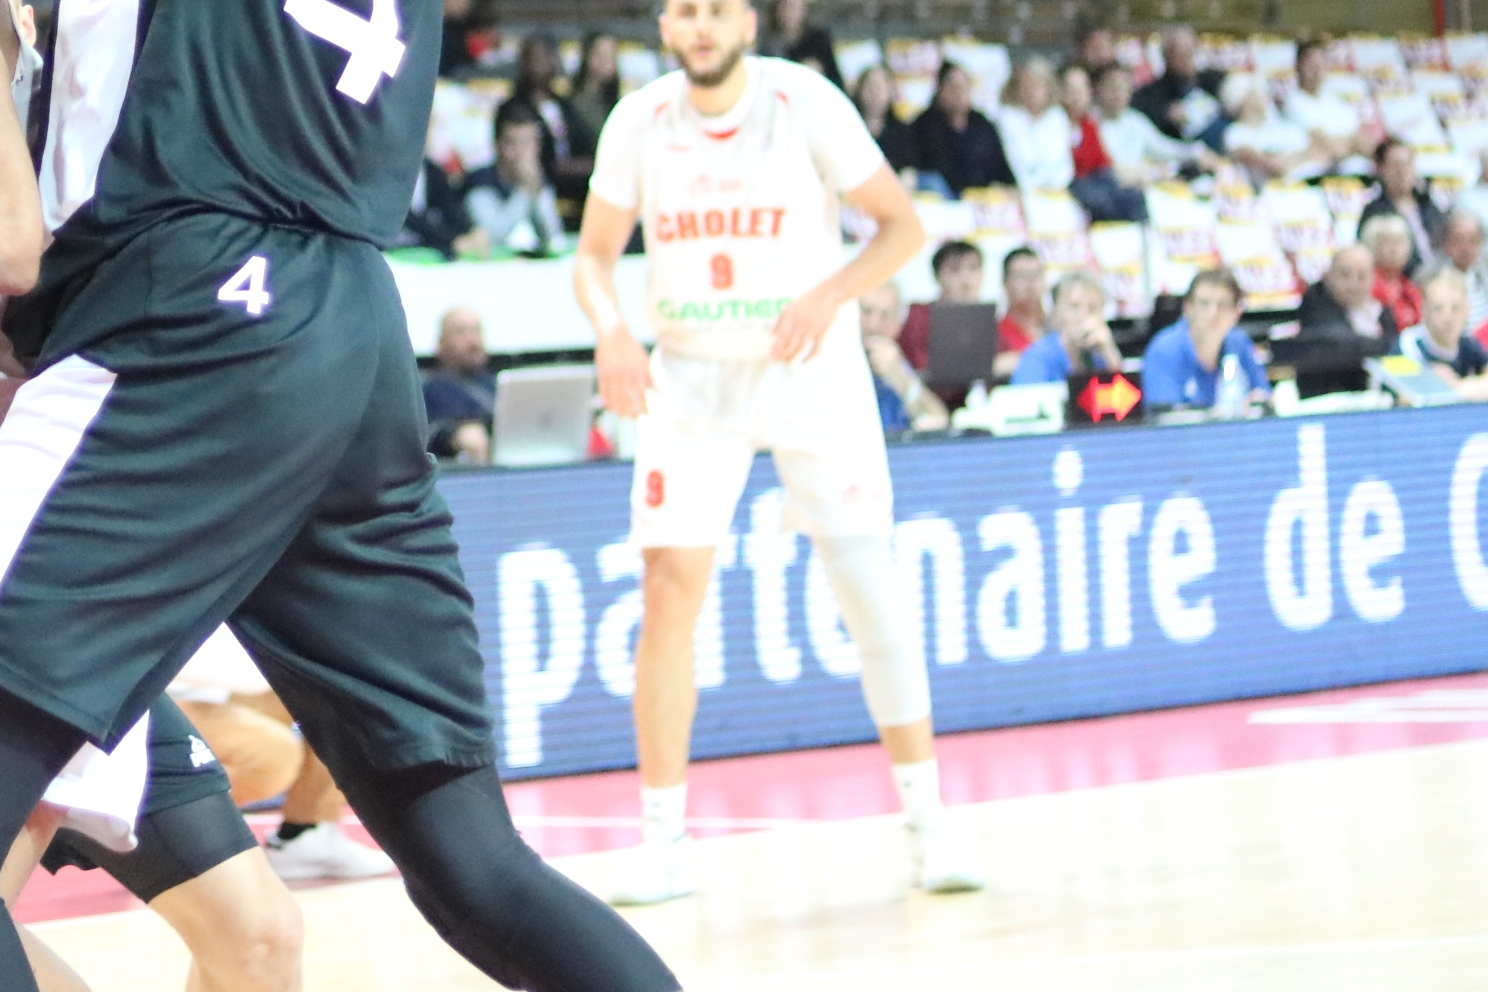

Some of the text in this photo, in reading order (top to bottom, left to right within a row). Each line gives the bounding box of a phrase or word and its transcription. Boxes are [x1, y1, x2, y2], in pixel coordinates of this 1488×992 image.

[656, 208, 787, 242] CHOLET
[218, 255, 271, 316] 4
[709, 252, 734, 291] 9
[645, 470, 665, 509] 9
[1264, 423, 1407, 631] de
